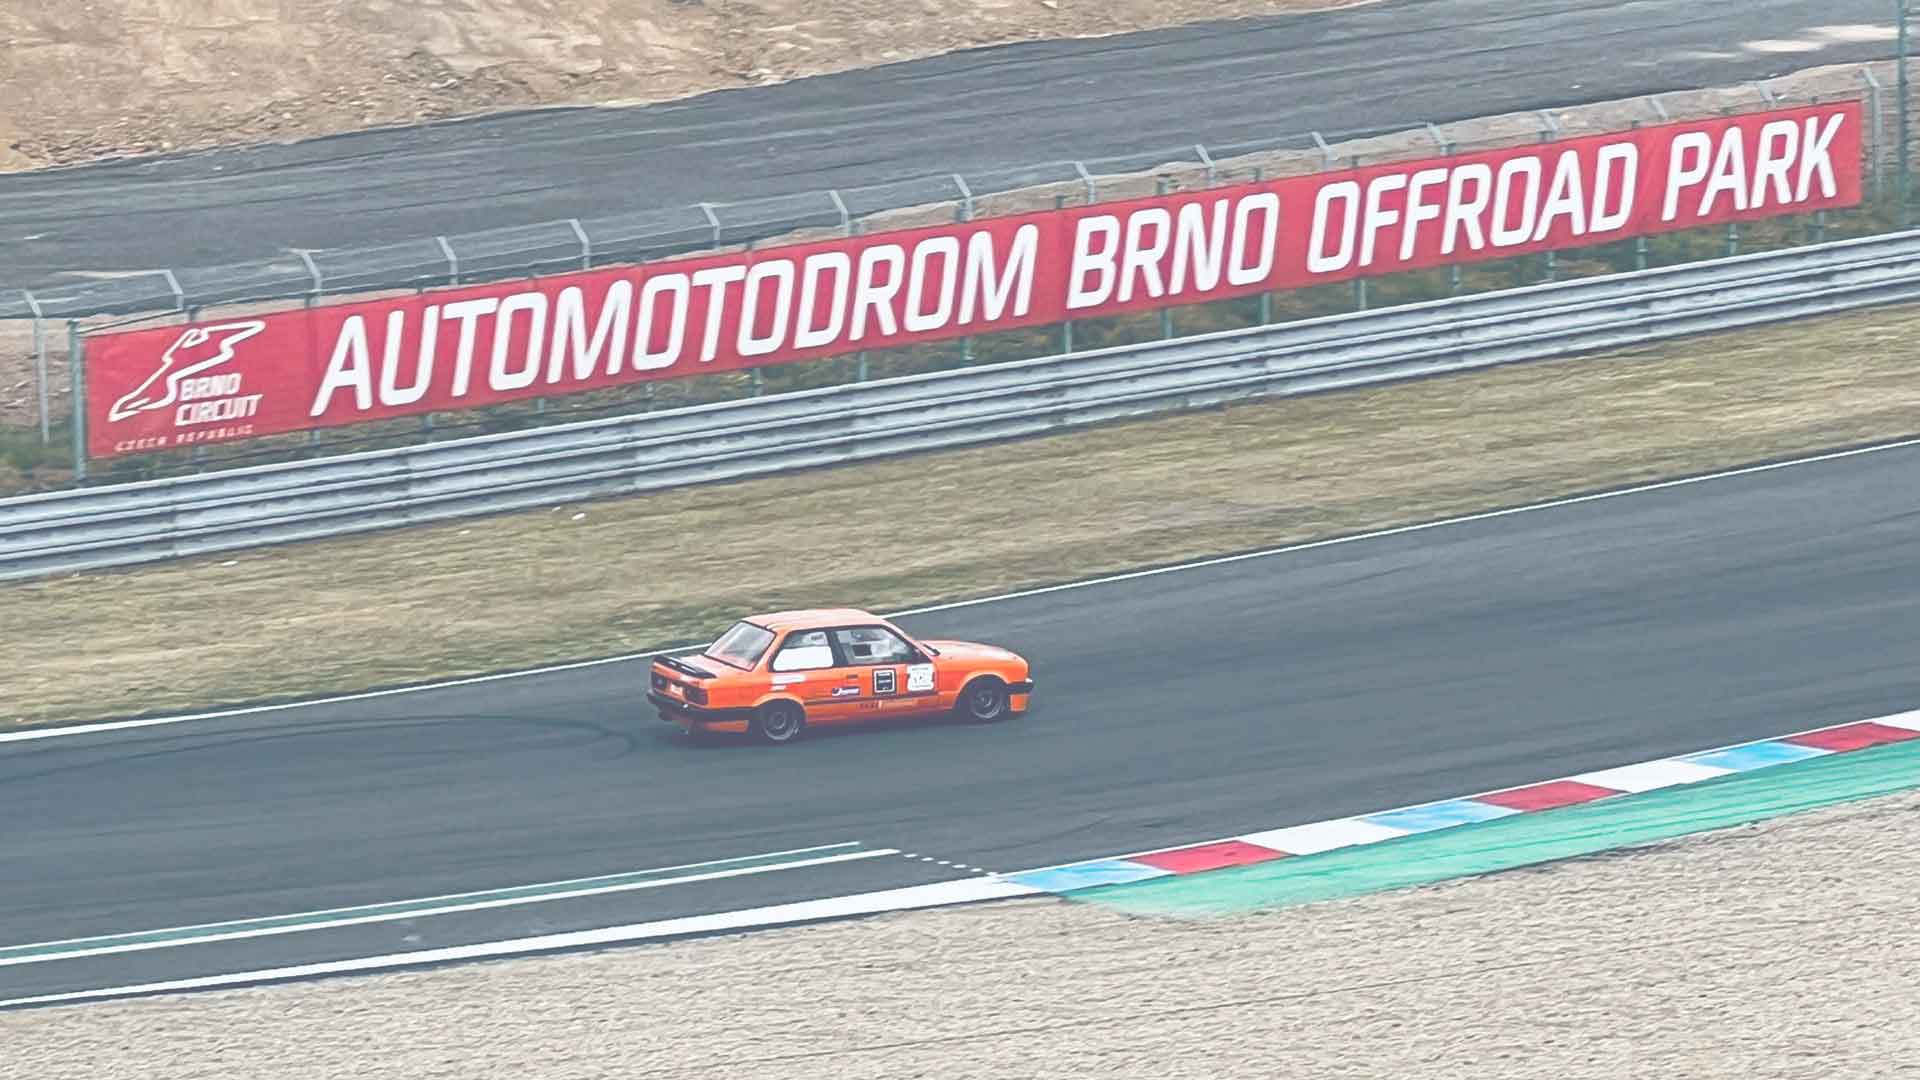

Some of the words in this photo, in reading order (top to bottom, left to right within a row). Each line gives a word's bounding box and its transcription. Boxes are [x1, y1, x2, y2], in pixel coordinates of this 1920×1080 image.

[309, 224, 1039, 417] AUTOMOTODROM
[1066, 192, 1281, 310] BRNO
[1306, 142, 1640, 274] OFFROAD
[1661, 112, 1846, 222] PARK
[179, 372, 243, 402] BRNO
[174, 393, 265, 426] CIRCUIT
